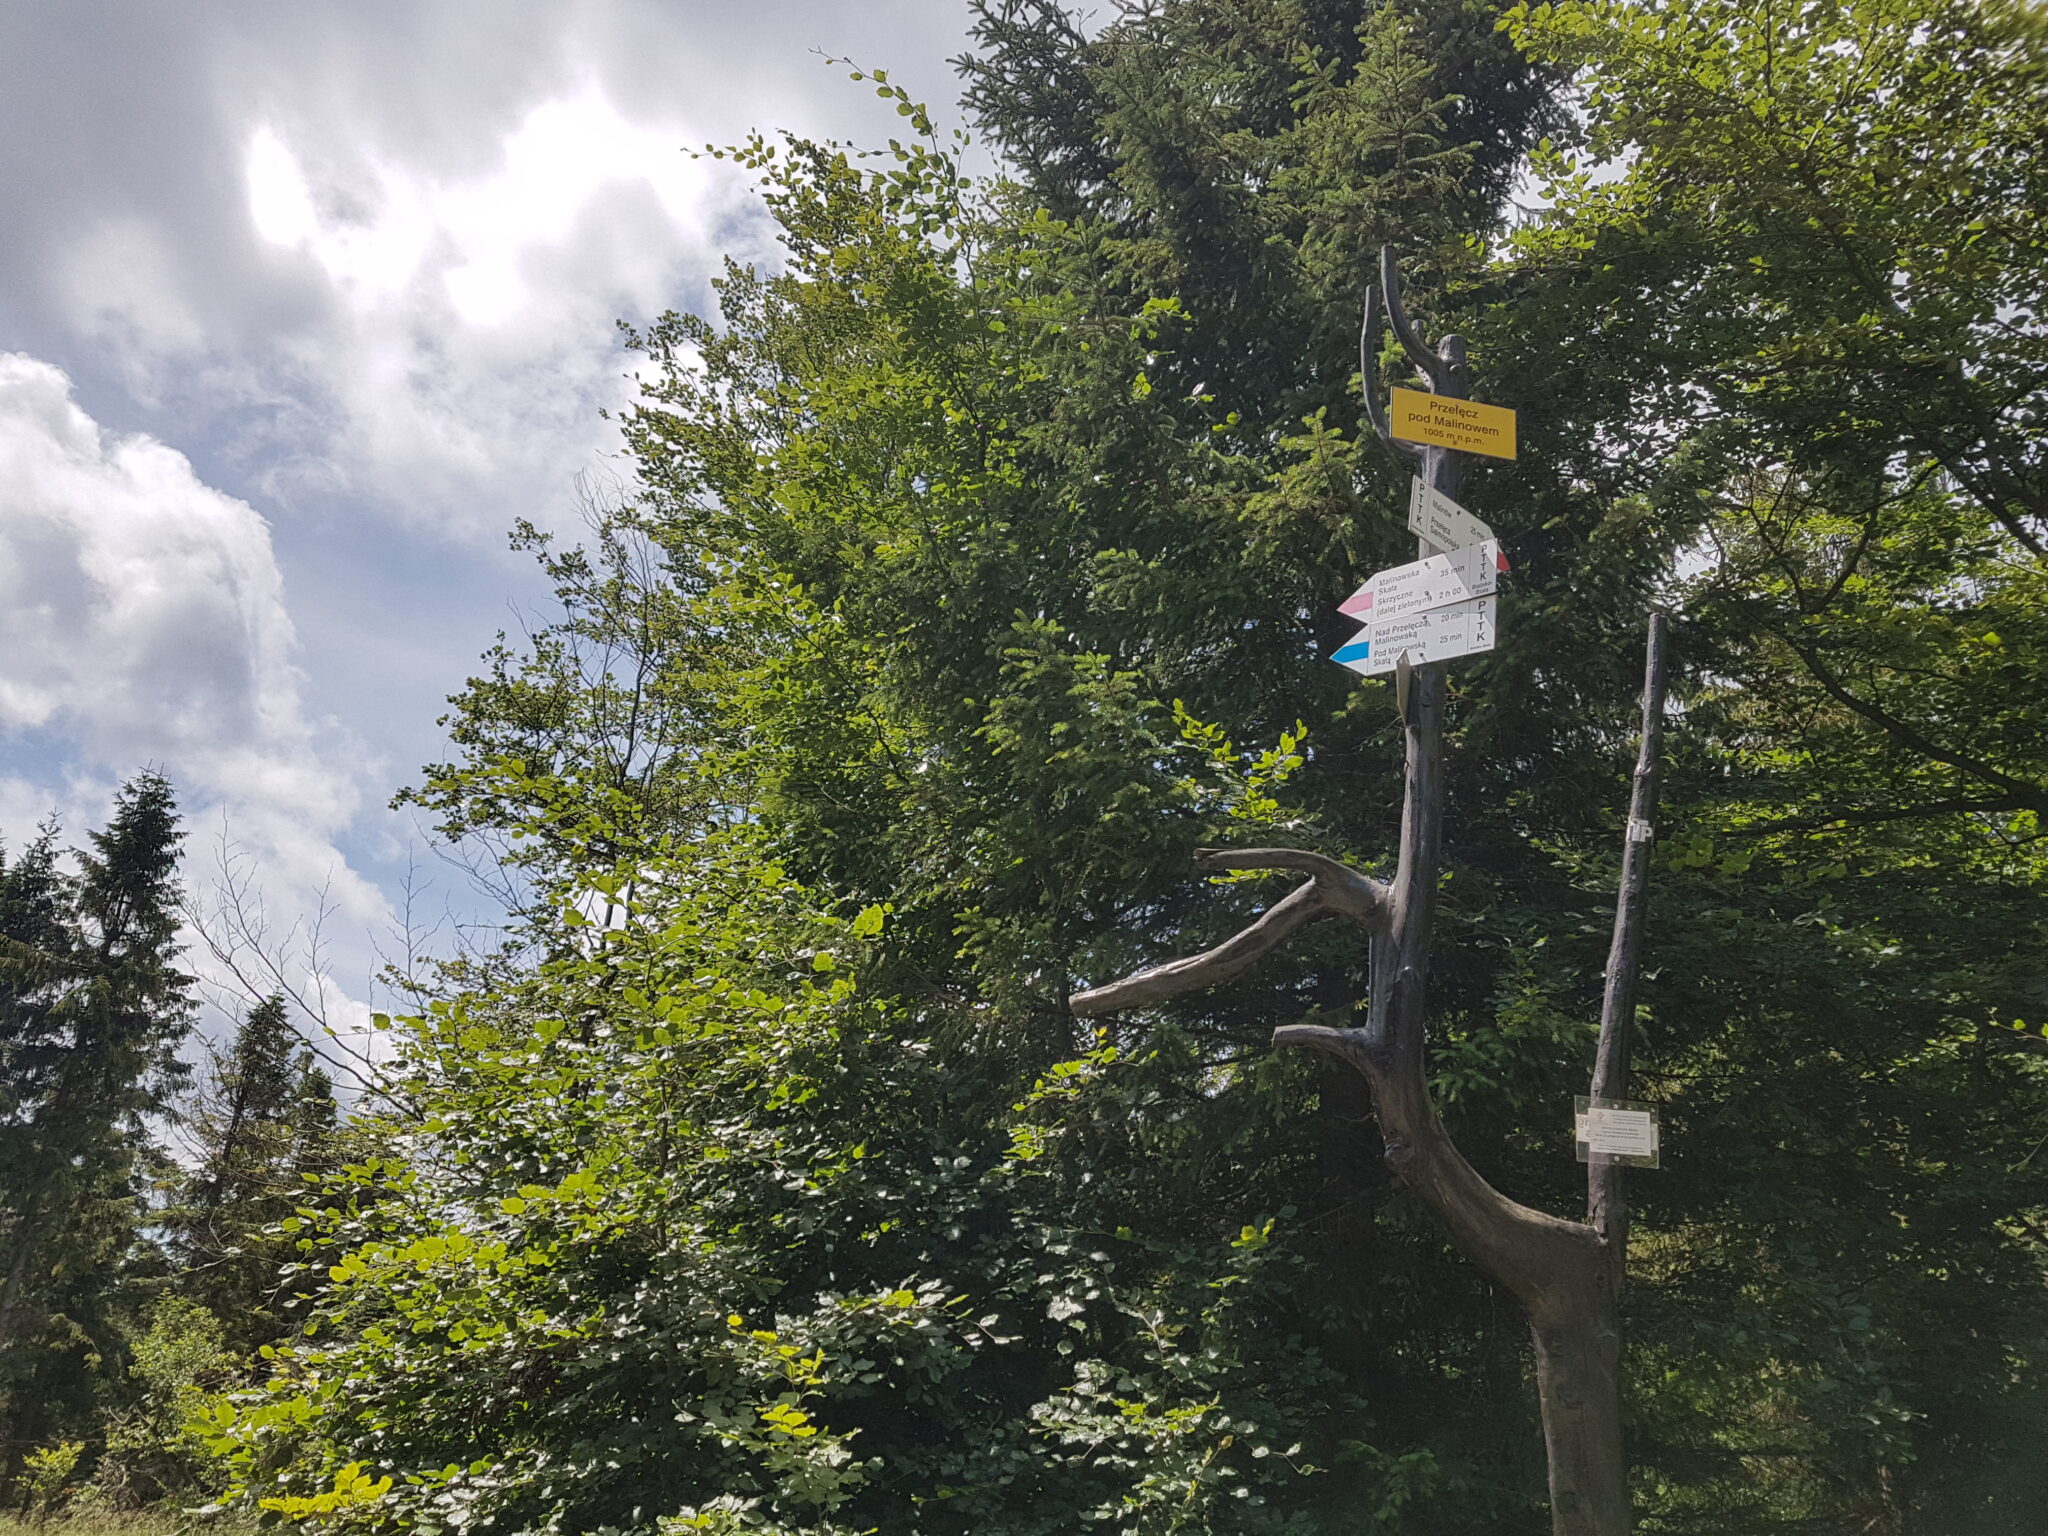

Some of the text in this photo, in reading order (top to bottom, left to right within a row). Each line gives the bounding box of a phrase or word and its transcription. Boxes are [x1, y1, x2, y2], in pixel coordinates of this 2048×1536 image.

[1430, 401, 1479, 419] Przełęcz
[1408, 412, 1500, 437] pod Malinowem
[1423, 427, 1444, 438] 1005
[1457, 434, 1485, 446] n.p.m.
[1416, 484, 1425, 526] PTTK
[1479, 544, 1488, 581] PTTK
[1379, 564, 1465, 587] Malinowska 35 min
[1376, 604, 1396, 617] (dalej
[1439, 591, 1444, 599] 2
[1445, 589, 1451, 597] h
[1452, 586, 1462, 596] 00
[1377, 590, 1414, 606] Skrzyczne
[1378, 584, 1398, 596] Skała
[1375, 627, 1390, 638] Nad
[1440, 614, 1450, 623] 20
[1450, 611, 1464, 620] min
[1476, 600, 1487, 642] PTTK
[1373, 649, 1387, 658] Pod
[1439, 635, 1449, 644] 25
[1449, 632, 1463, 642] min
[1374, 631, 1418, 646] Malinowską
